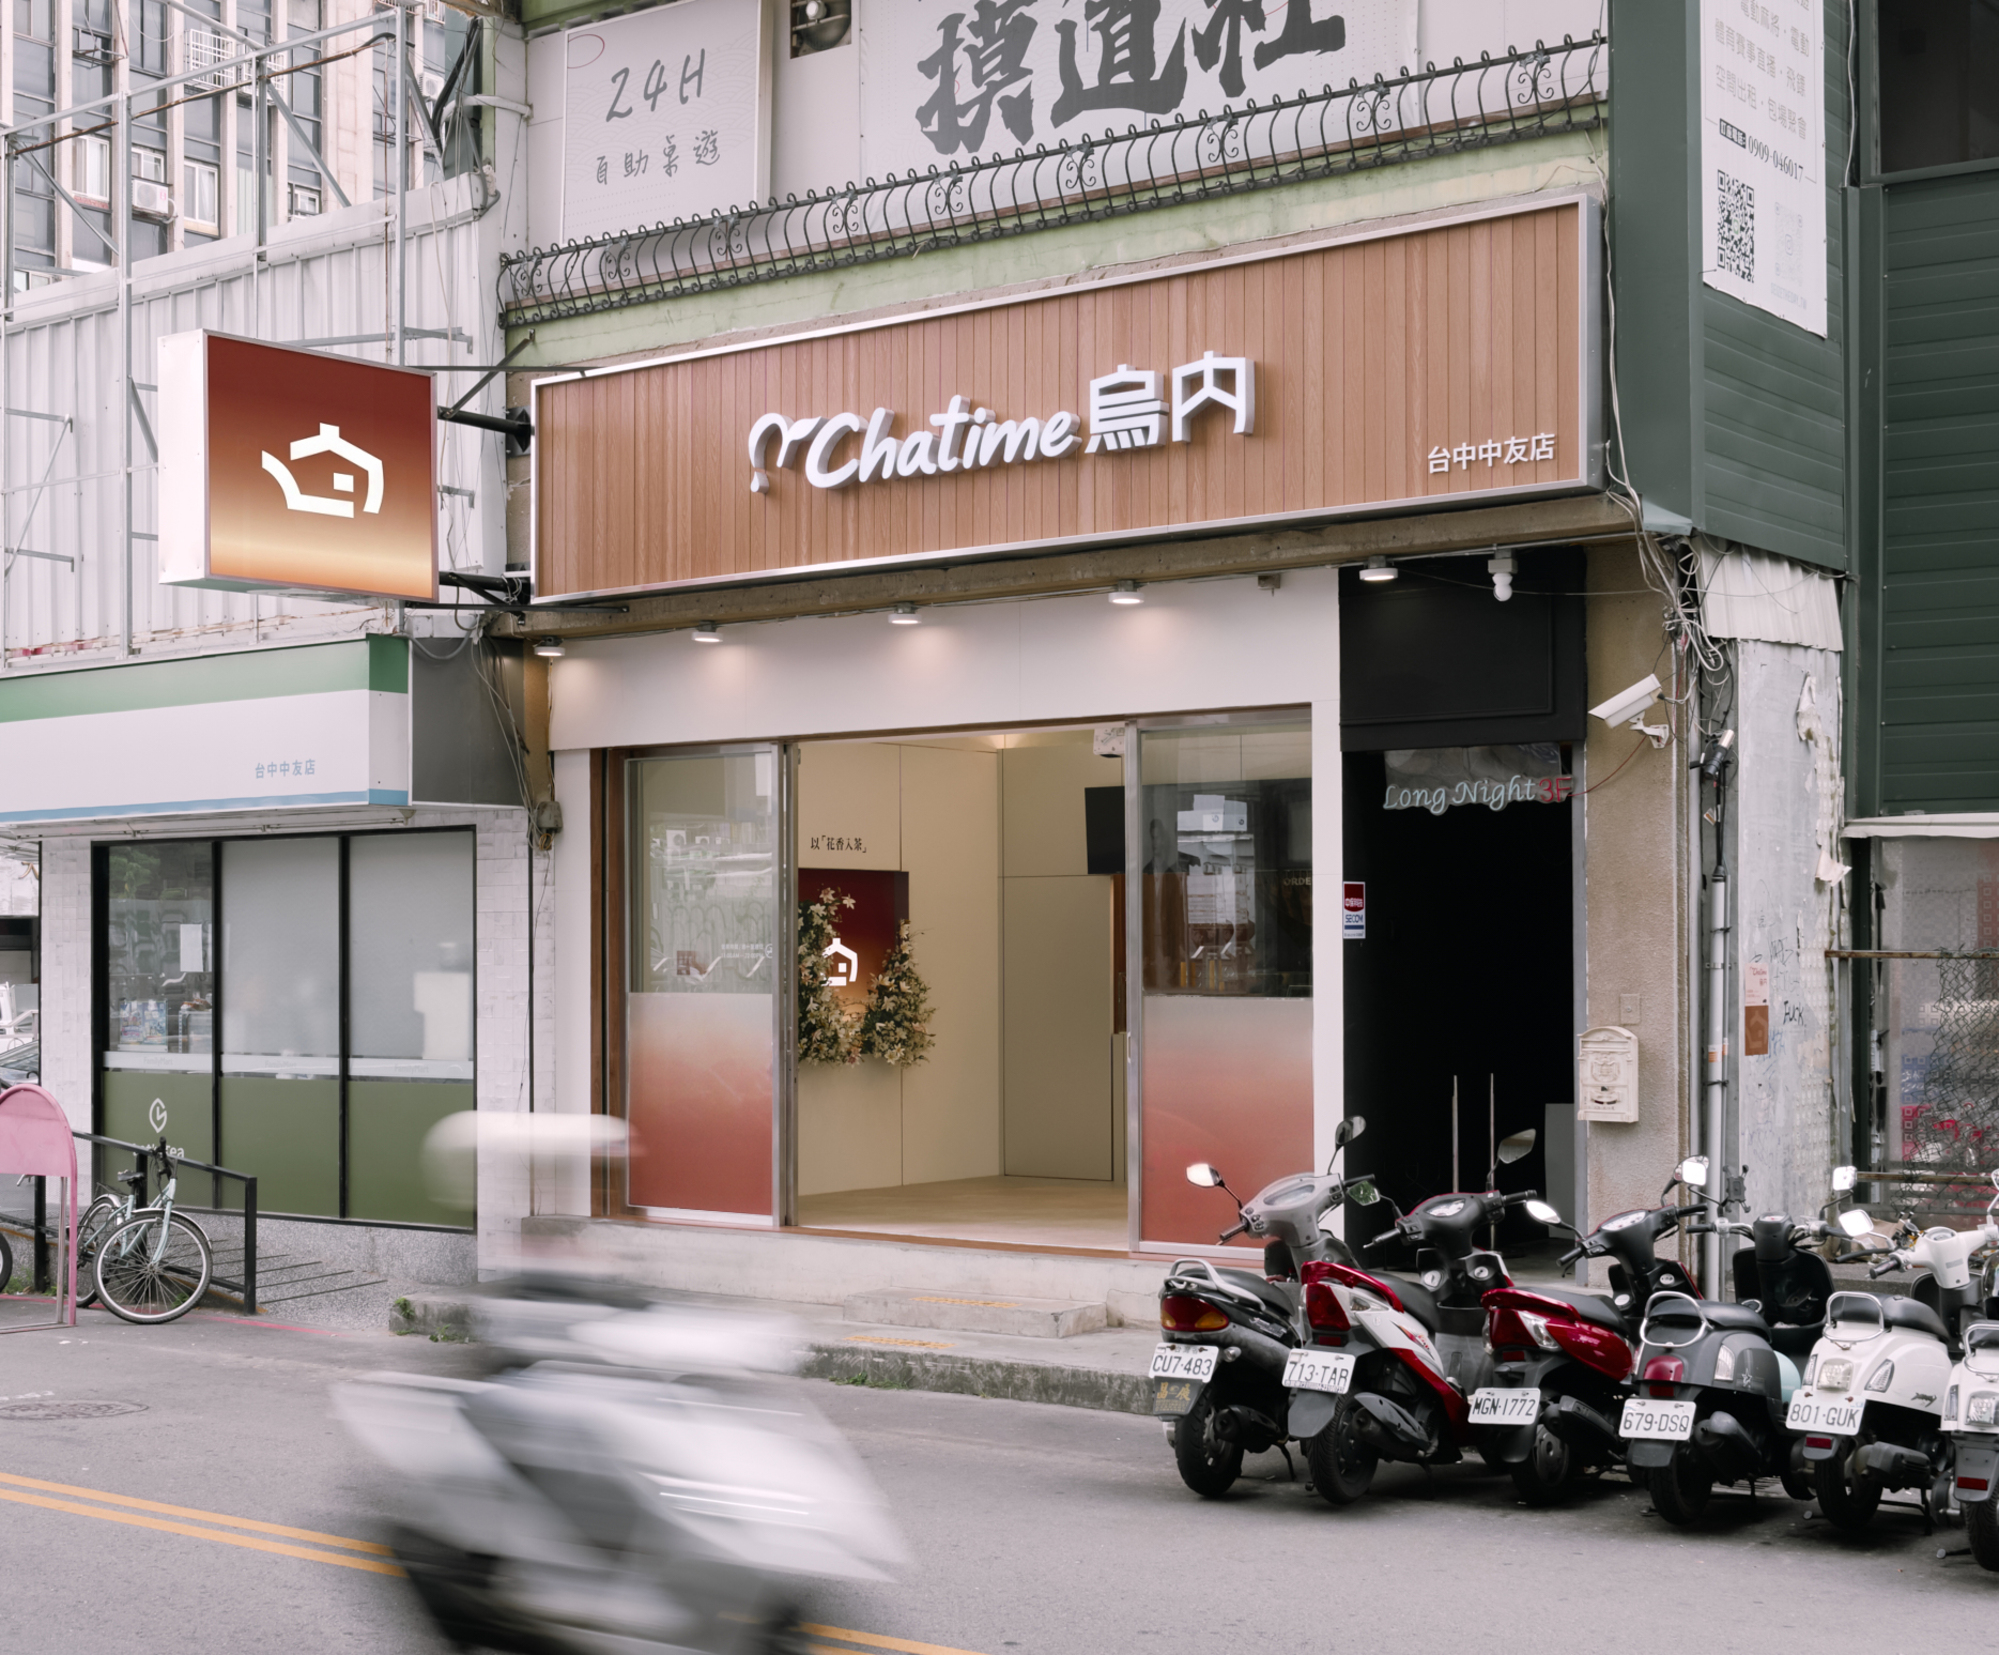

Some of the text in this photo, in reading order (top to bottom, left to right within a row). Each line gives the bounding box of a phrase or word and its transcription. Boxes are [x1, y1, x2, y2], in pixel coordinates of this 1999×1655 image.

[606, 48, 705, 122] 24H
[805, 394, 1083, 489] Chatime
[1427, 432, 1556, 474] 台中中友店
[254, 758, 316, 779] 台中中友店
[1383, 774, 1572, 814] Long Night 3F
